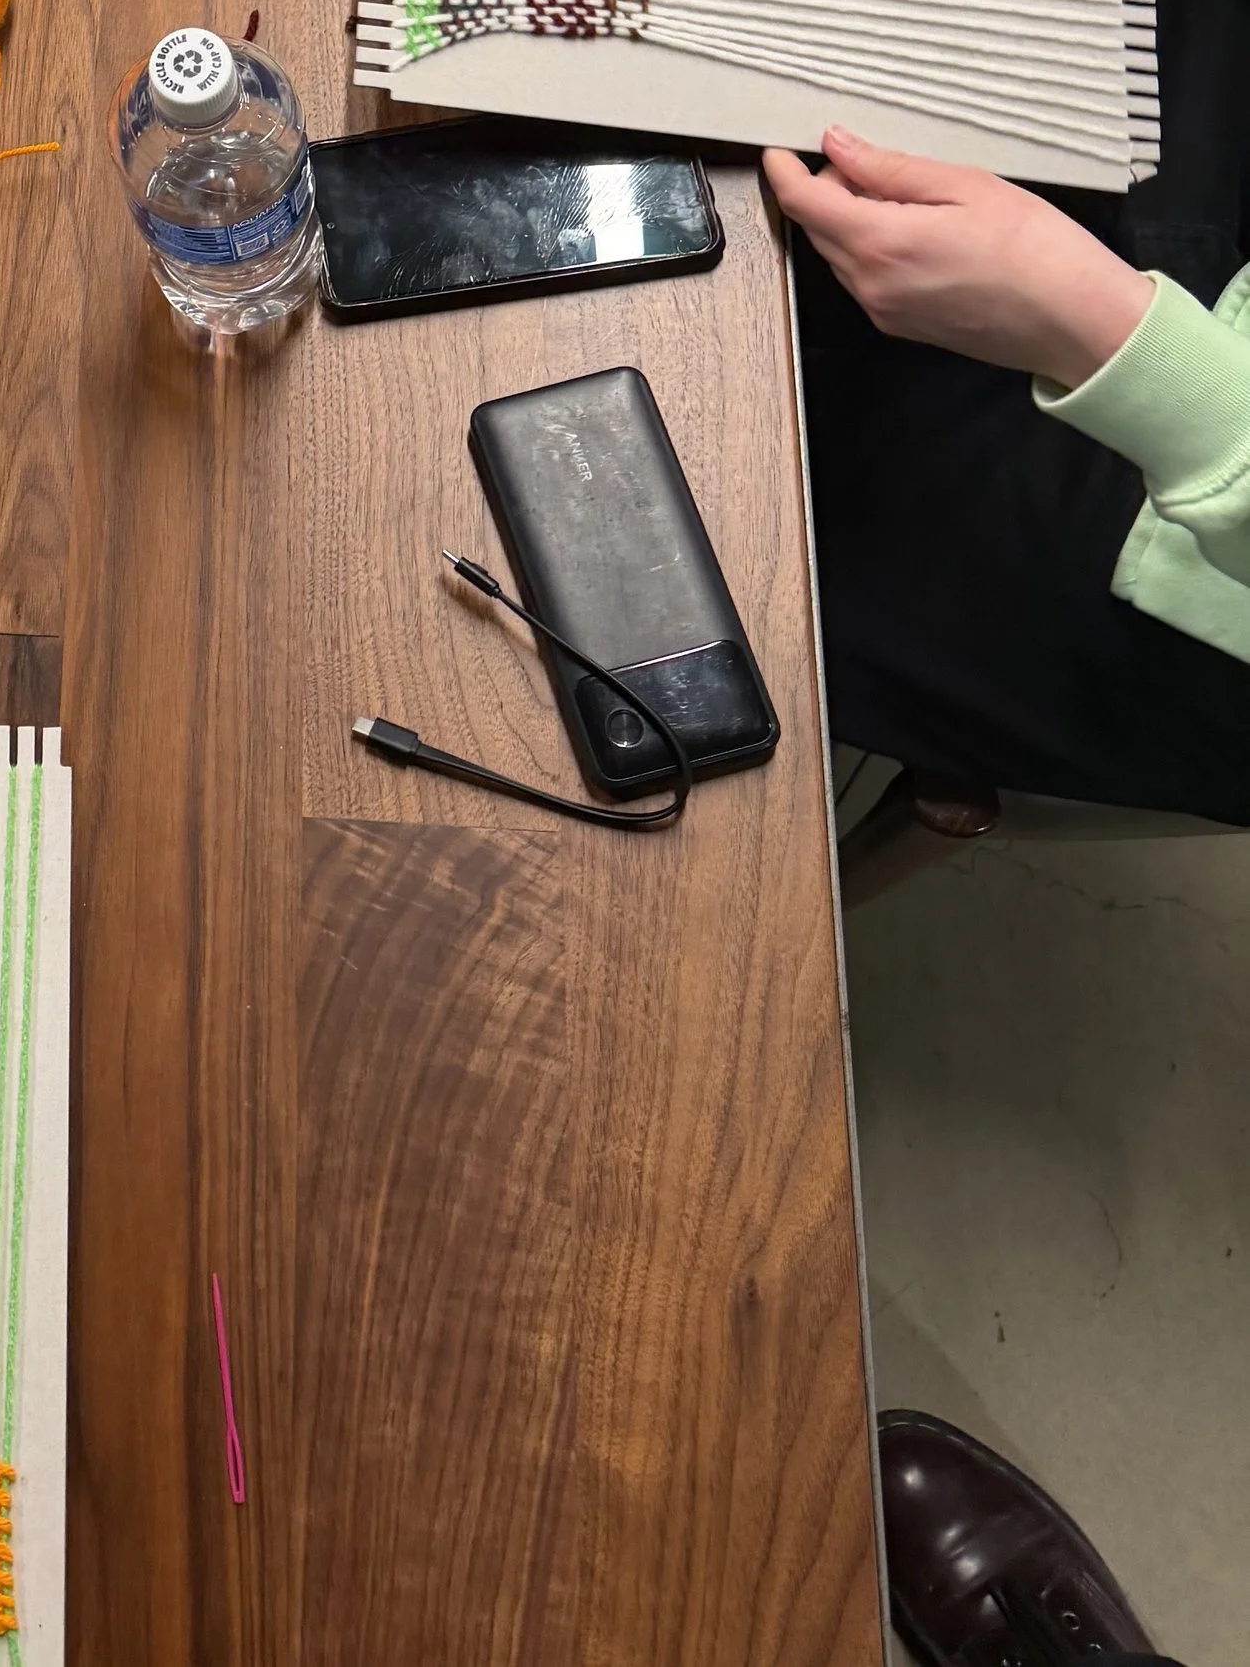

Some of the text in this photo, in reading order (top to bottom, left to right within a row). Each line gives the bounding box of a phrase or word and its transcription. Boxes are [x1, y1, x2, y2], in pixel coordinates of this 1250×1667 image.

[155, 34, 187, 94] RECYCLE BOTTLE
[196, 37, 222, 91] WITH CAP ON
[564, 432, 593, 483] ANKER
